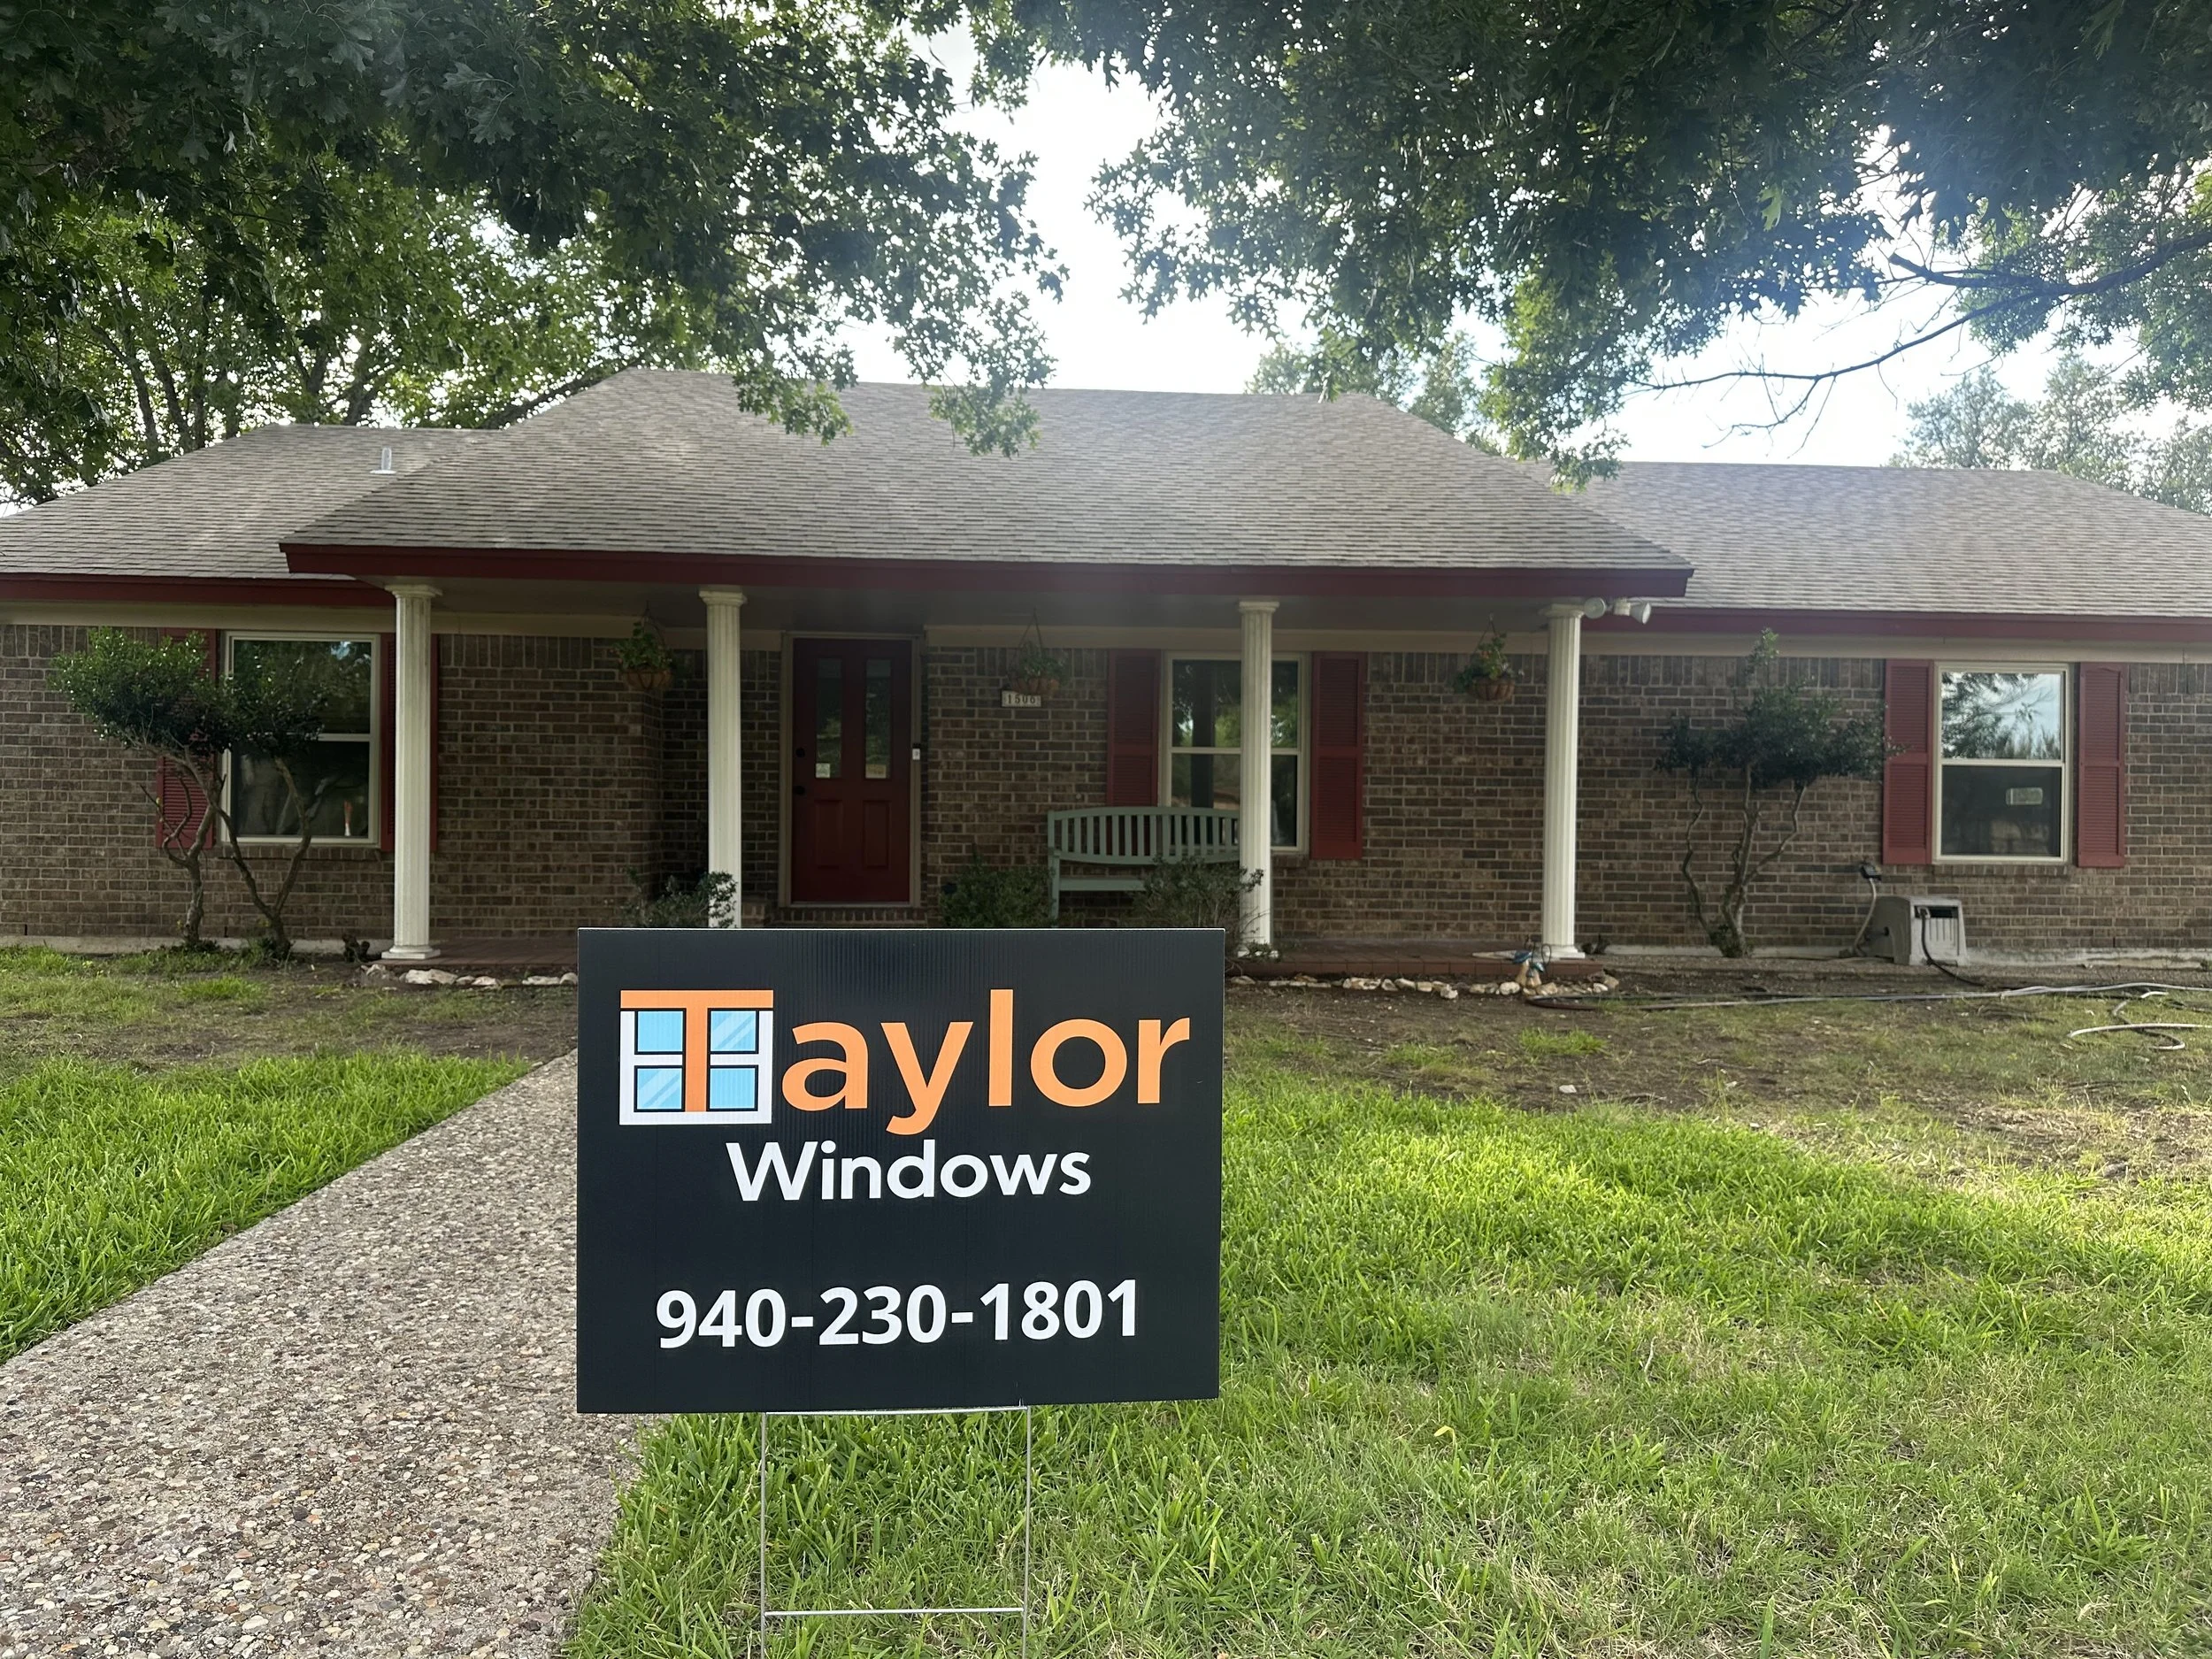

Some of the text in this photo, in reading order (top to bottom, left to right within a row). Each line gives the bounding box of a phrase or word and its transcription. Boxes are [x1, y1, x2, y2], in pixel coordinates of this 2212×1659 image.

[620, 988, 1190, 1135] Taylor
[726, 1139, 1092, 1202] Windows
[657, 1279, 1137, 1348] 940-230-1801
